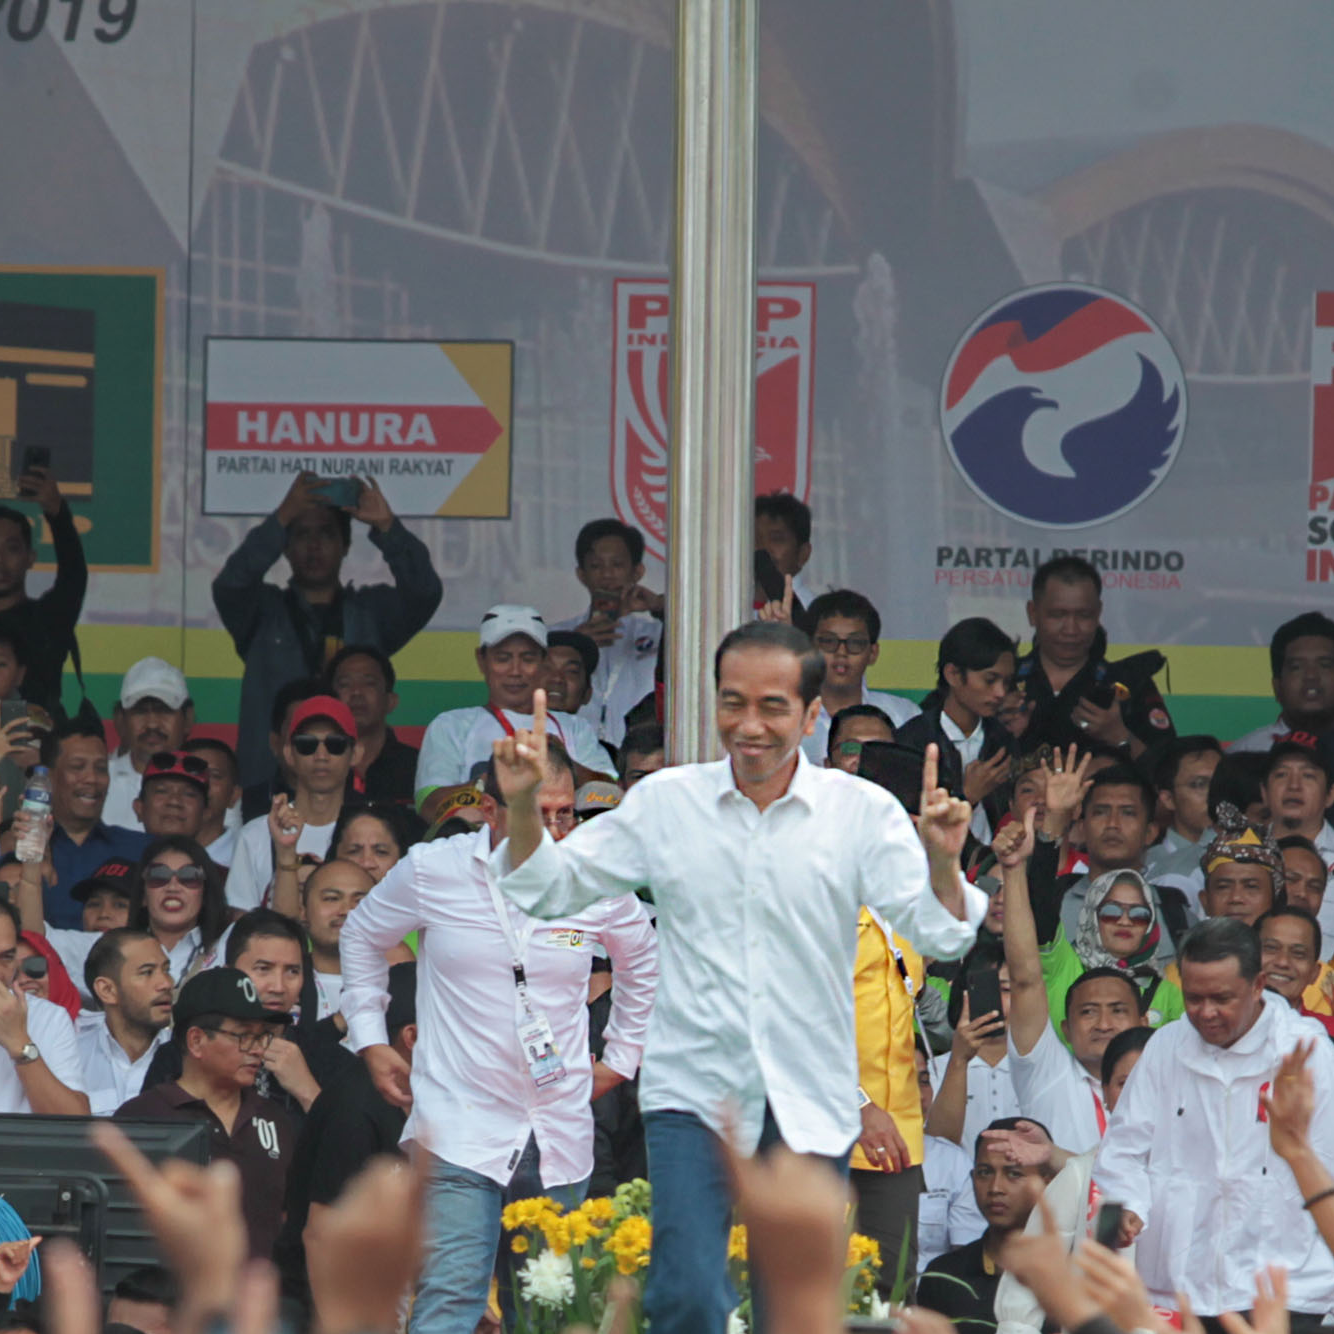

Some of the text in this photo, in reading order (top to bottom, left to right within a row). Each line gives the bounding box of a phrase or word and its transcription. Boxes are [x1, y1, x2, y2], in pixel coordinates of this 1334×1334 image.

[628, 294, 801, 332] PP
[237, 410, 437, 446] HANURA
[218, 456, 454, 477] PARTAI HATI NURANI RAKYAT
[936, 546, 1042, 569] PARTAI
[935, 569, 1032, 588] PERSATU
